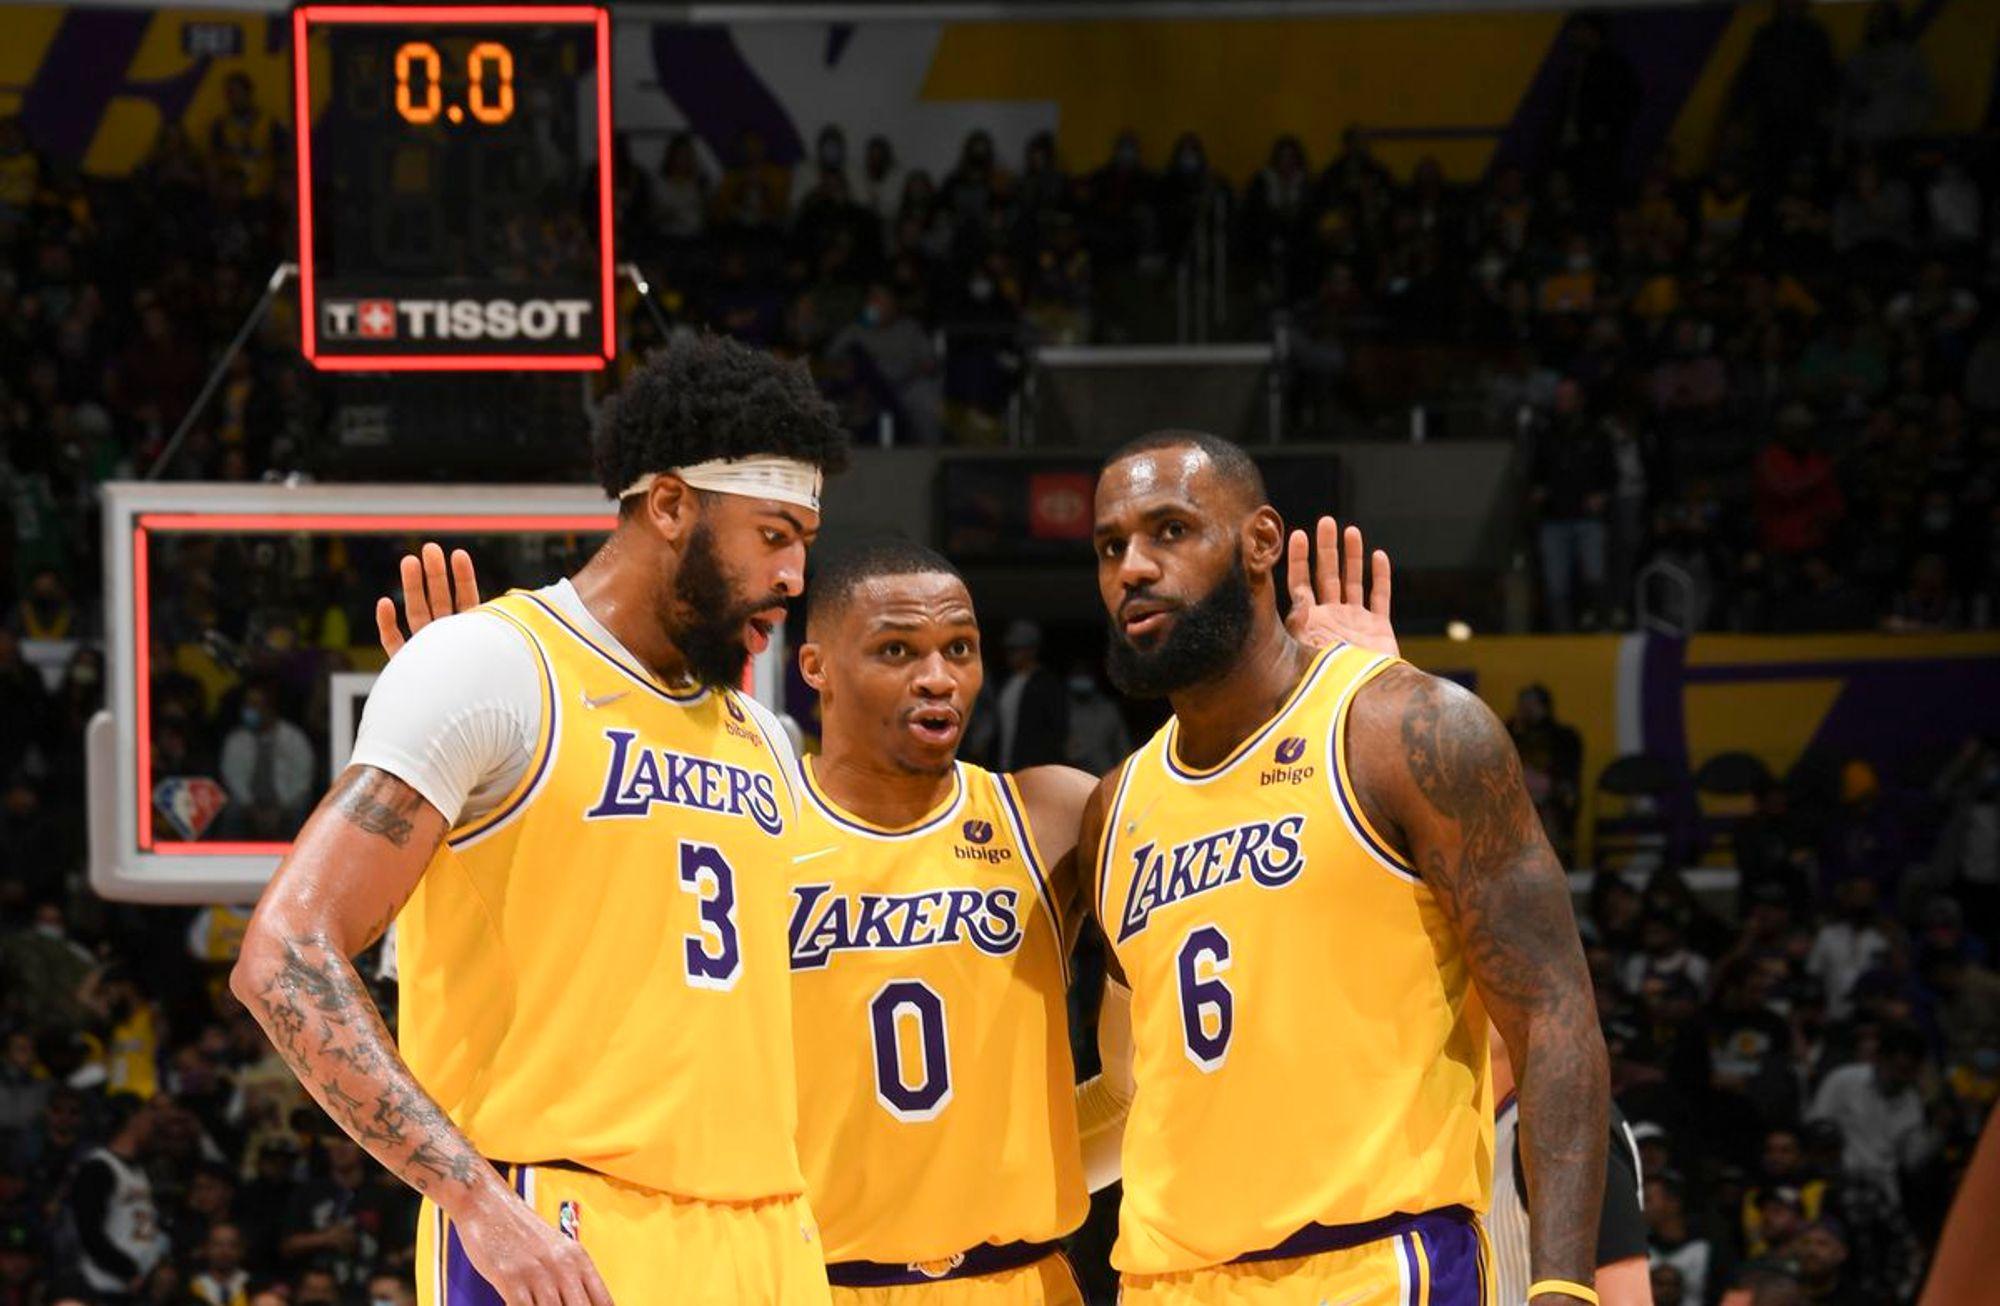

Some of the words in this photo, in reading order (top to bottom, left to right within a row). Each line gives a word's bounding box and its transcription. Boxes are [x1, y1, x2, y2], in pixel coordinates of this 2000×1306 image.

[394, 42, 515, 124] 0.0
[398, 300, 592, 338] TISSOT
[586, 729, 783, 836] LAKERS
[1260, 766, 1314, 787] bibigo
[954, 846, 1011, 863] bibigo
[1116, 816, 1305, 945] LAKERS
[679, 839, 741, 990] 3
[788, 883, 1022, 971] LAKERS
[1178, 924, 1234, 1070] 6
[869, 979, 953, 1121] 0
